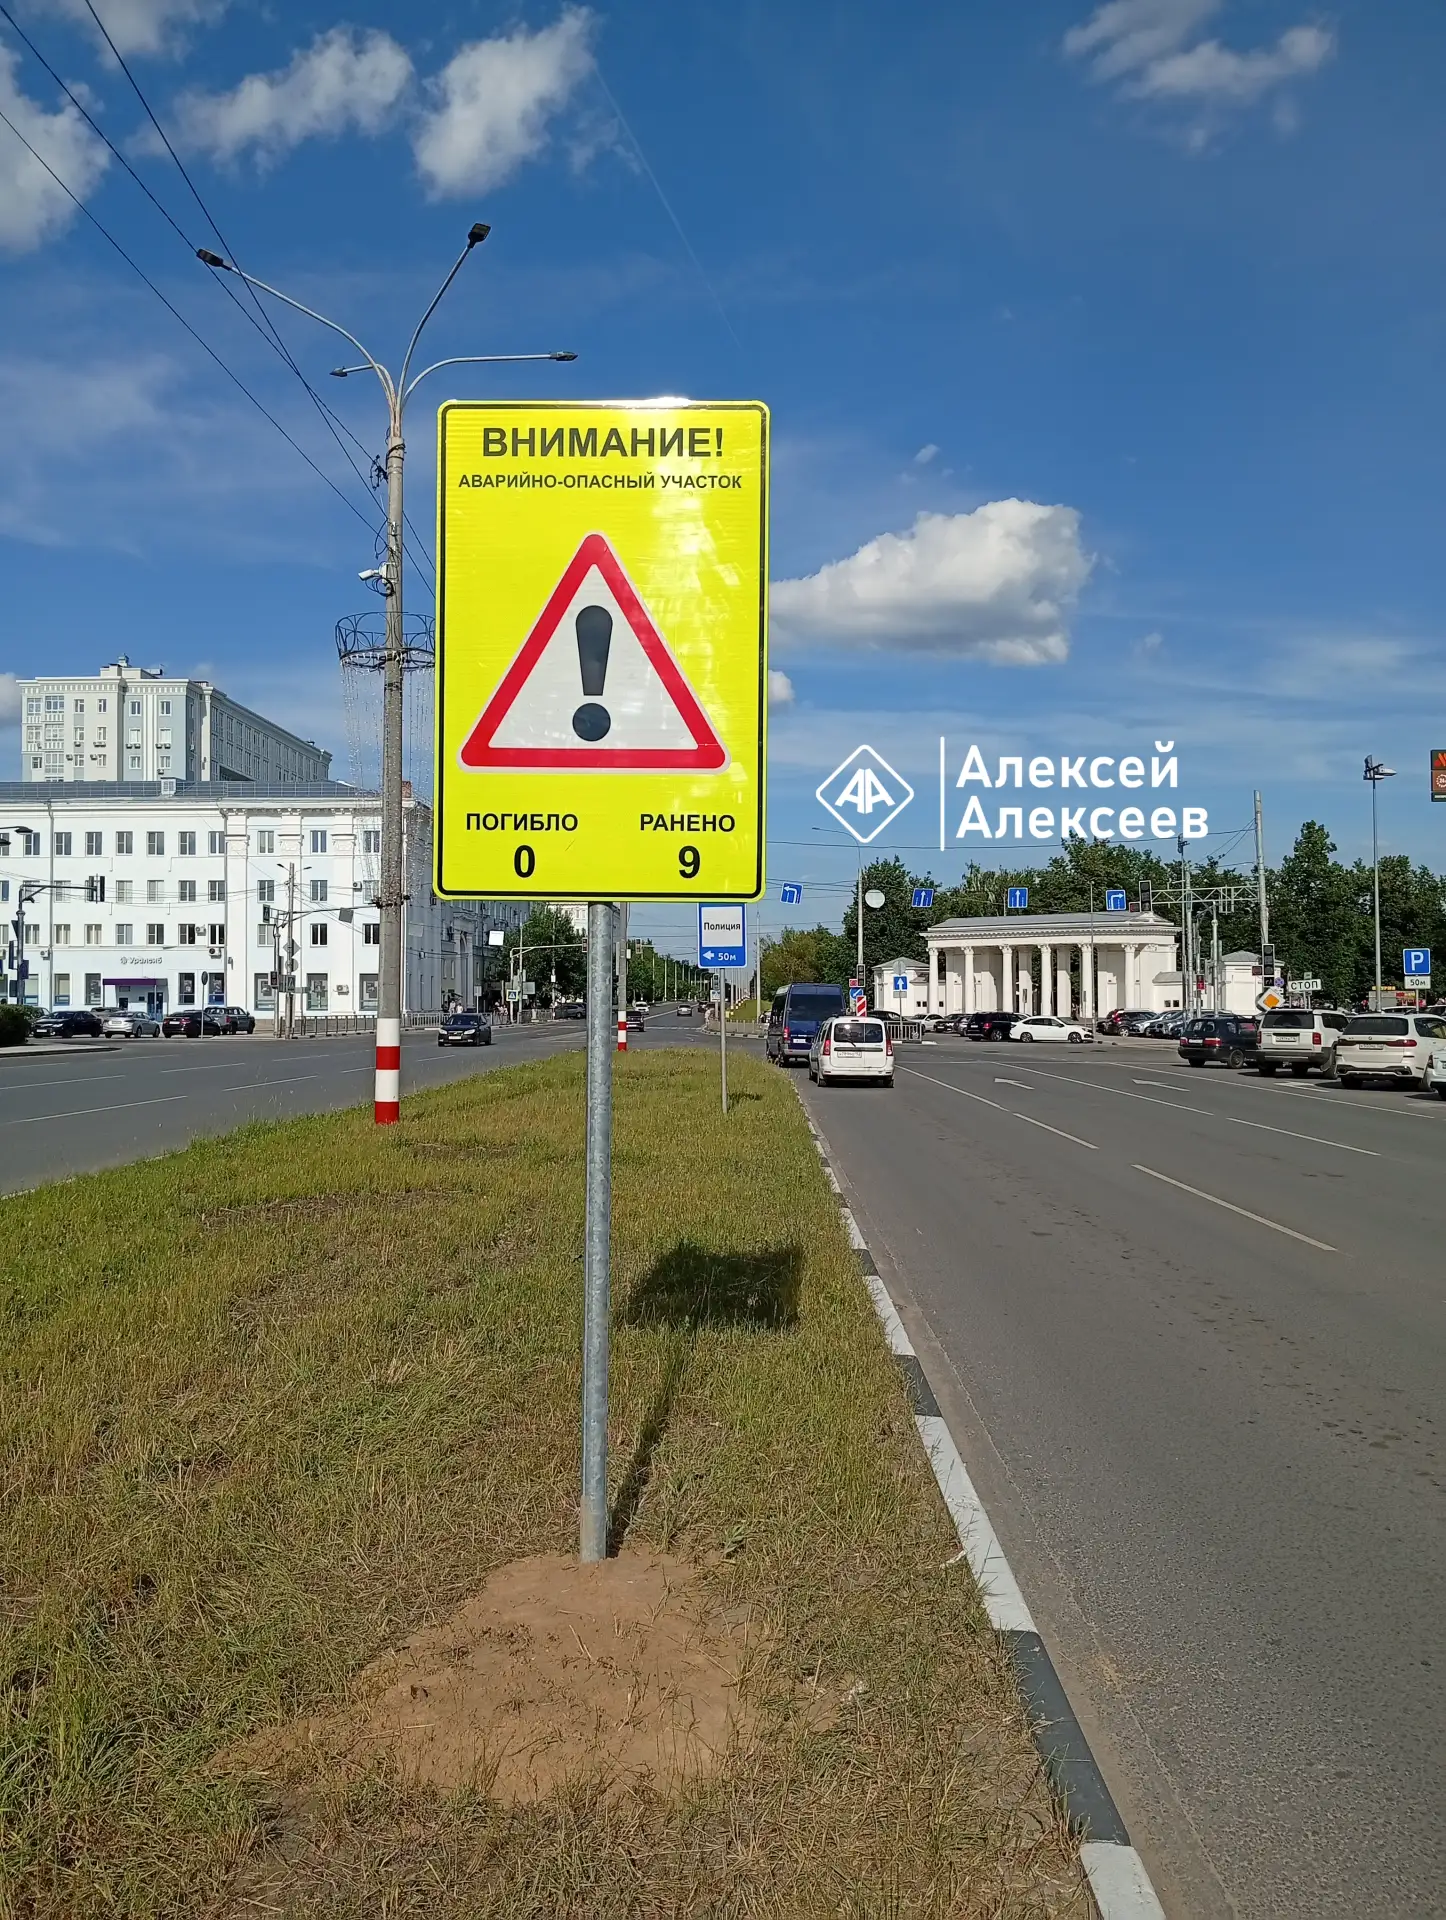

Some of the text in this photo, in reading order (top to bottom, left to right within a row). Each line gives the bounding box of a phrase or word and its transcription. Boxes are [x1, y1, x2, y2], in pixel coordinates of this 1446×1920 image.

[482, 427, 724, 458] ВНИМАНИЕ!
[458, 471, 742, 490] АВАРИЙНО-ОПАСНЫЙ УЧАСТОК
[466, 813, 578, 832] ПОГИБЛО
[639, 813, 736, 832] РАНЕНО
[513, 844, 536, 879] 0
[677, 844, 701, 880] 9
[703, 921, 741, 933] Полиция
[717, 952, 737, 962] 50м
[1411, 951, 1424, 971] P
[1290, 980, 1318, 990] СТОП
[1410, 978, 1425, 986] 50м
